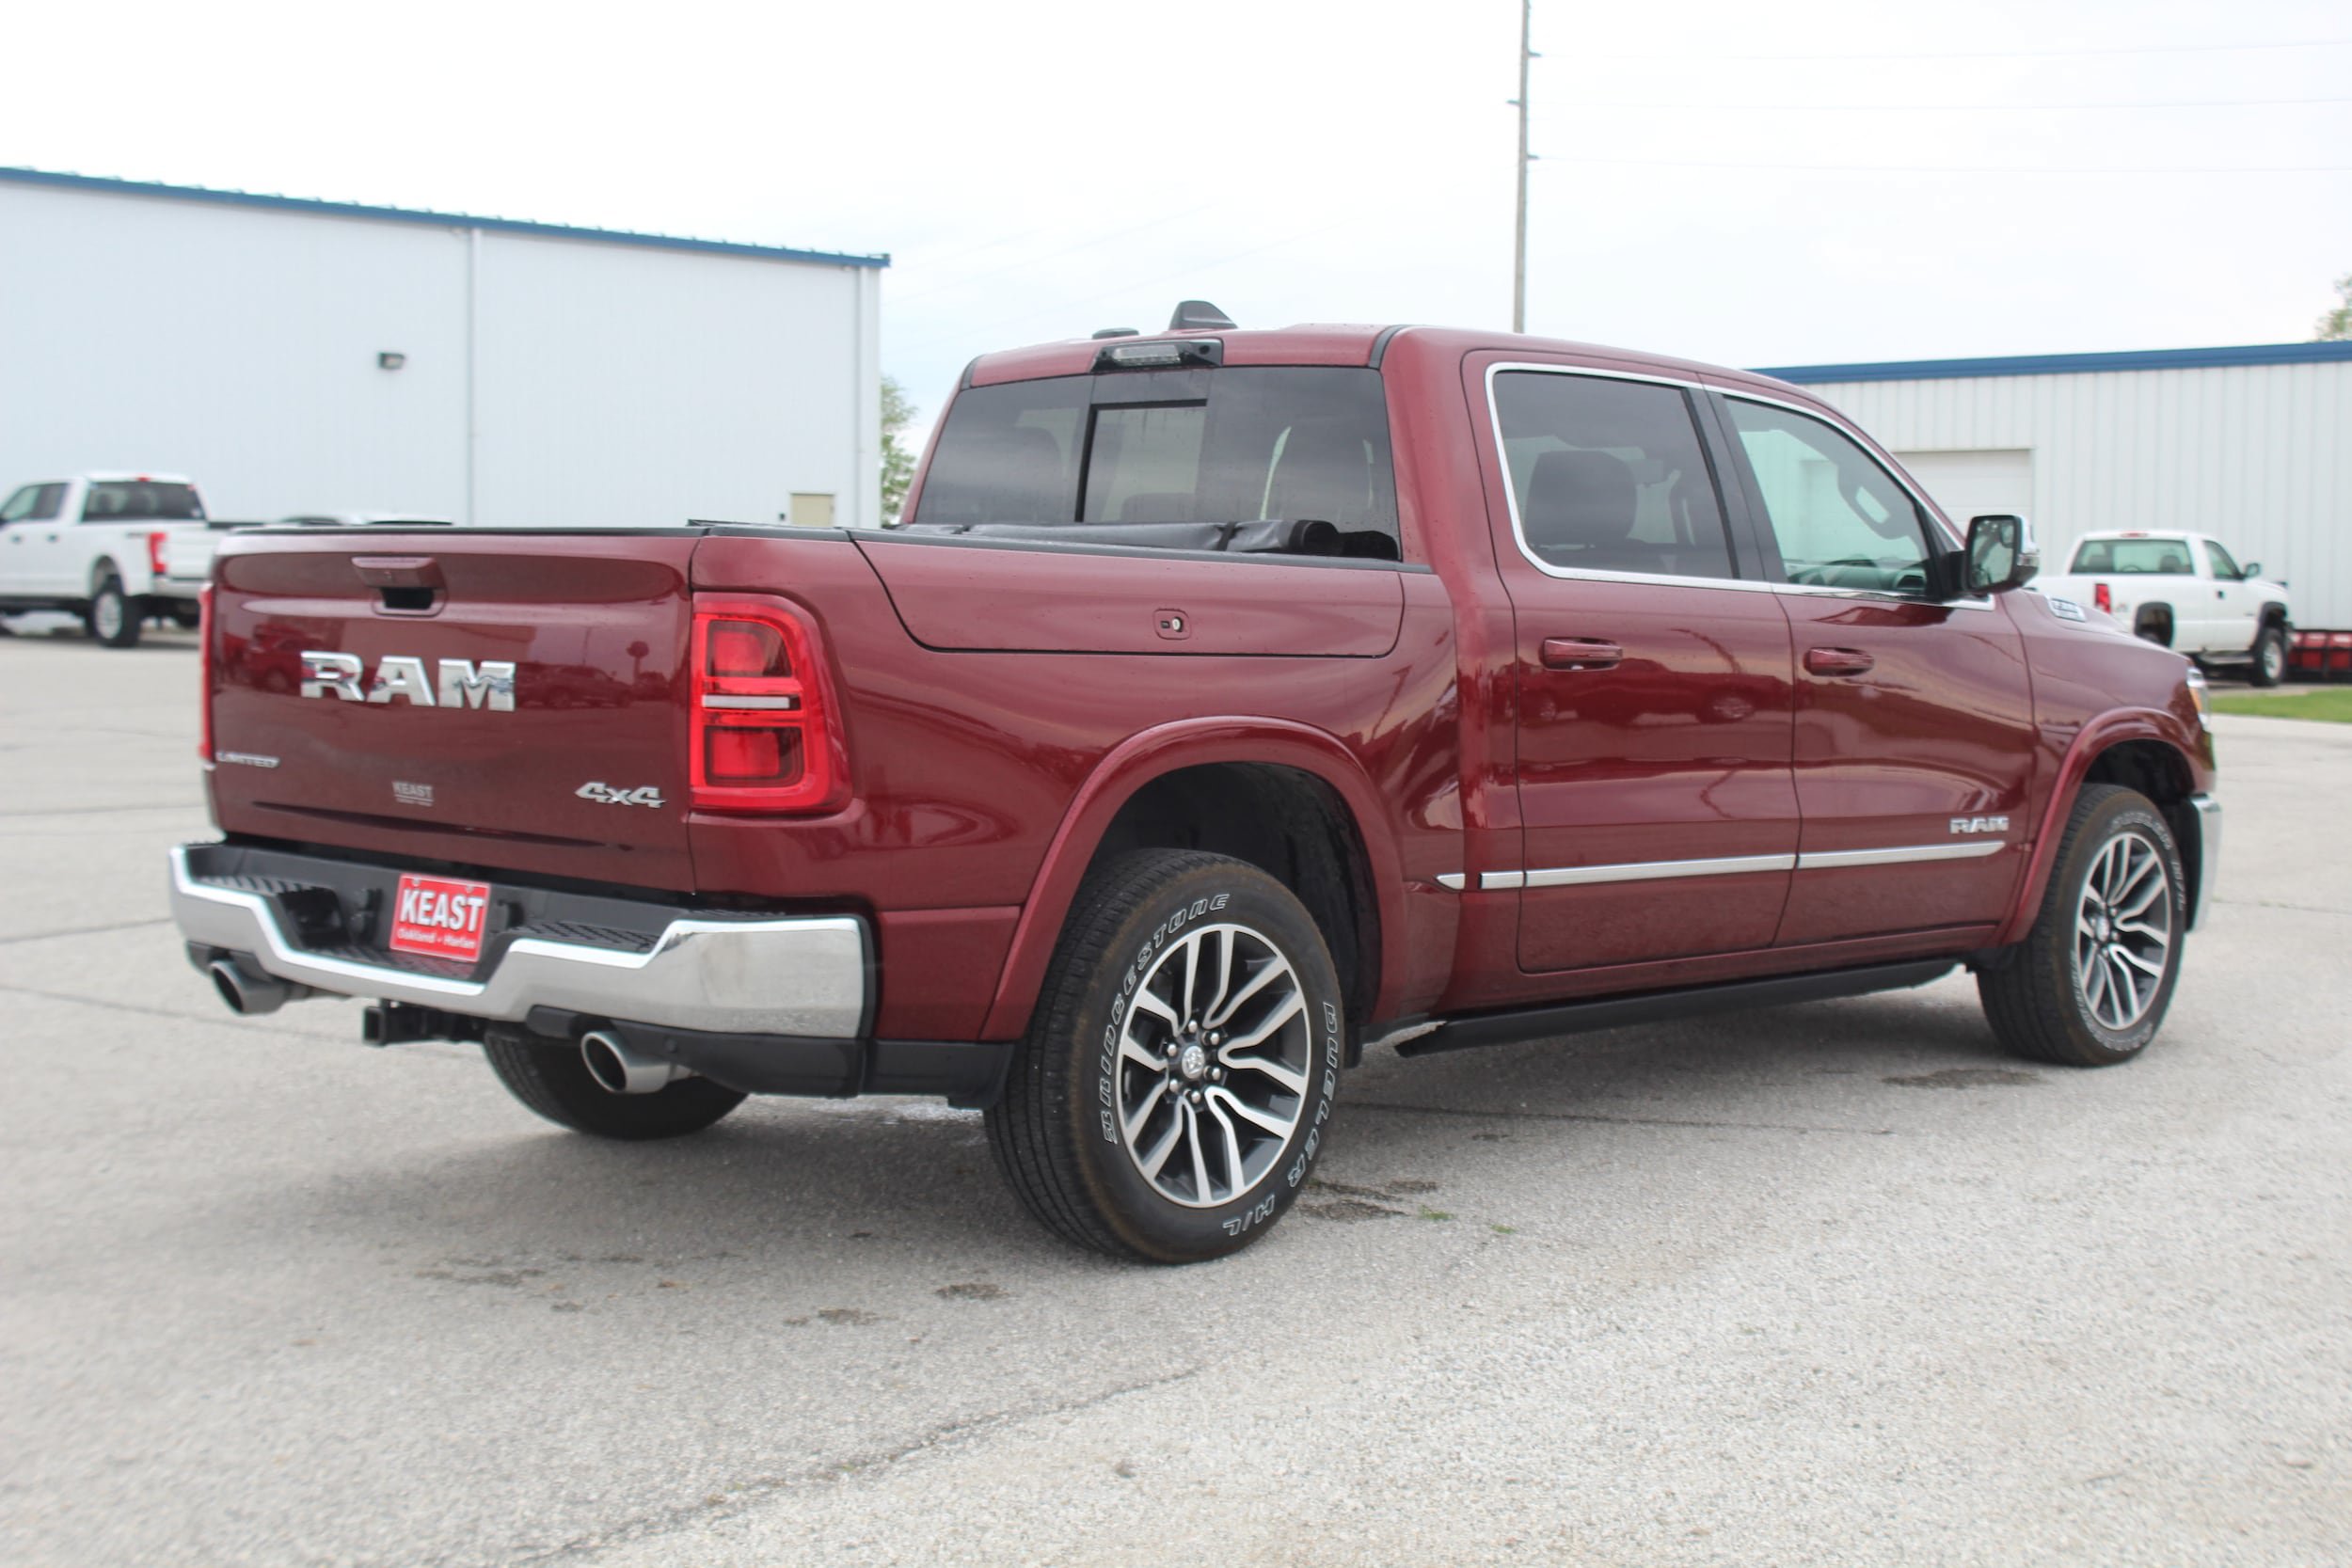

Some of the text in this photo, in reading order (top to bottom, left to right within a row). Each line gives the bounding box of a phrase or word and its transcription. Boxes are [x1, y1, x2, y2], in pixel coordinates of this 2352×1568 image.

[300, 650, 516, 712] RAM
[391, 781, 433, 799] KEAST
[1950, 816, 2009, 834] RAM
[400, 888, 485, 932] KEAST
[1099, 893, 1231, 1145] BRIDGESTONE
[1222, 1002, 1340, 1237] DUELER H/L
